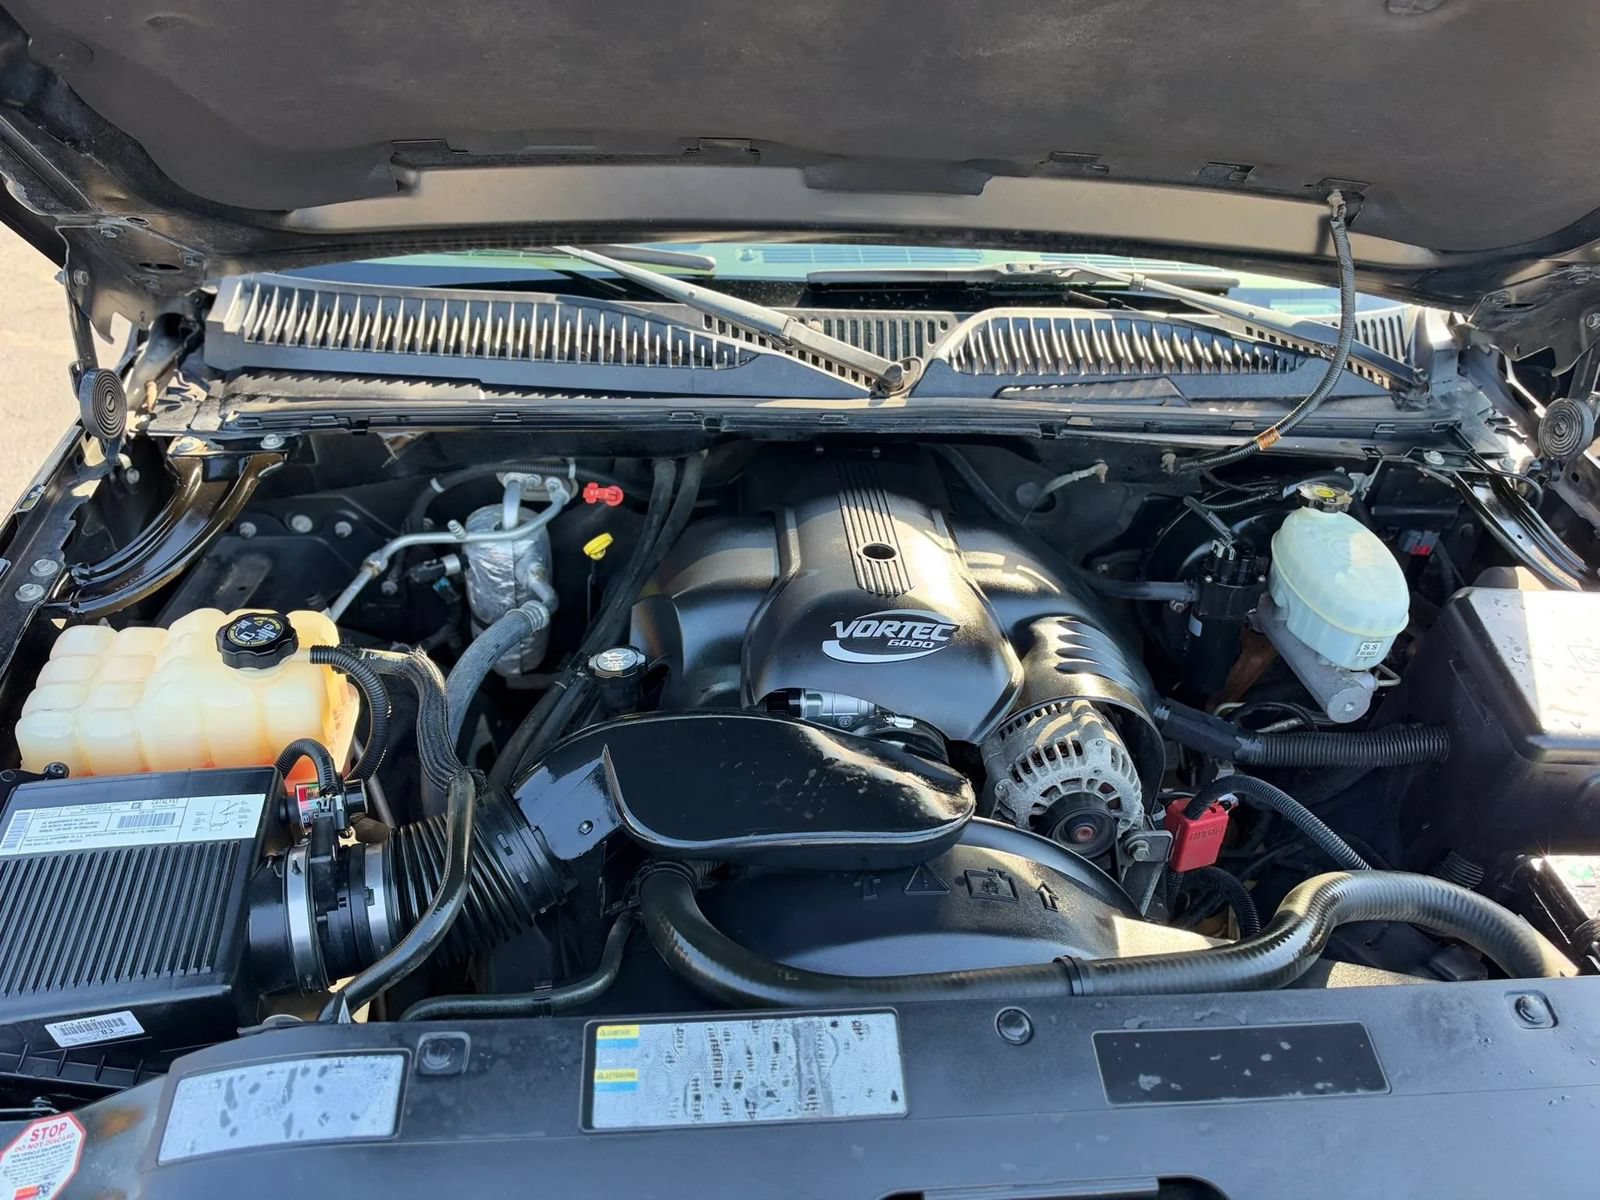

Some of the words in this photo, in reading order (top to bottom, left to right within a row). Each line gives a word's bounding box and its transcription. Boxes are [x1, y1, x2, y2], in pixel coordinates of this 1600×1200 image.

[830, 620, 958, 642] VORTEC
[887, 639, 935, 649] 6000
[30, 1122, 68, 1142] STOP
[27, 1141, 43, 1149] NOT
